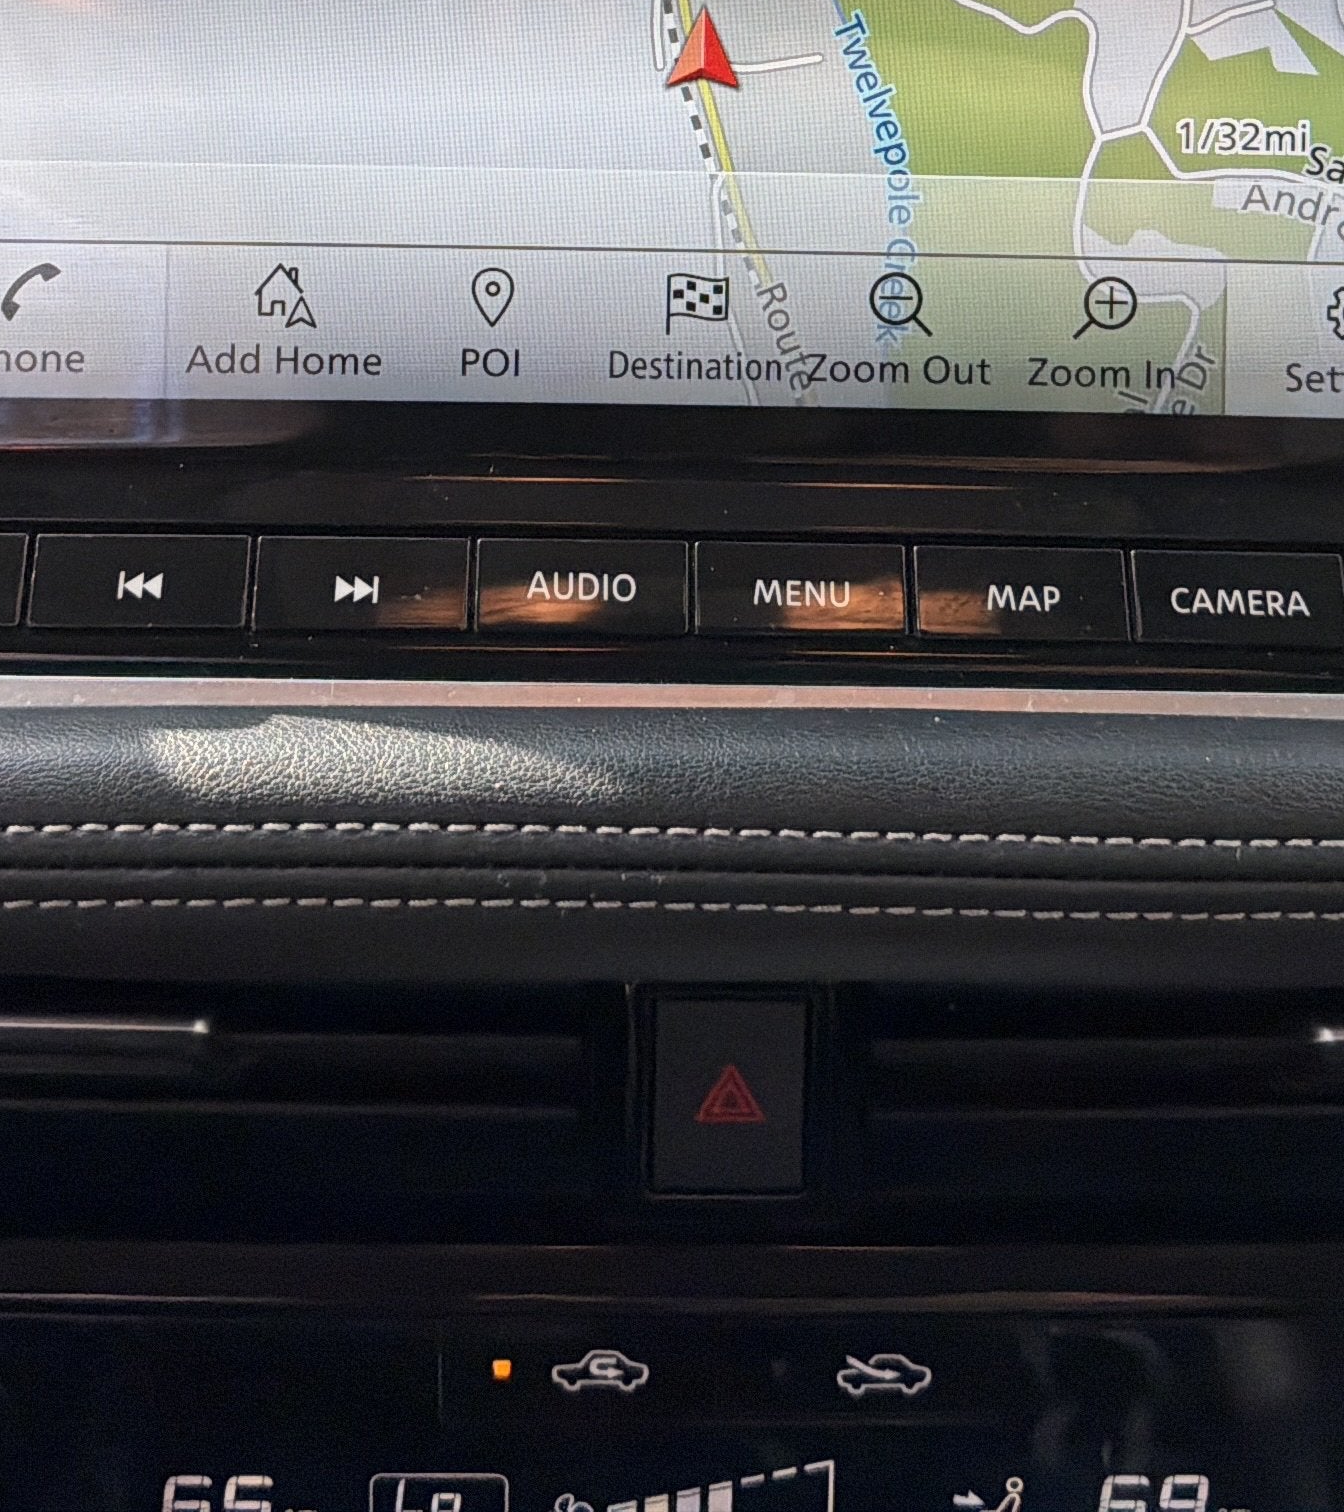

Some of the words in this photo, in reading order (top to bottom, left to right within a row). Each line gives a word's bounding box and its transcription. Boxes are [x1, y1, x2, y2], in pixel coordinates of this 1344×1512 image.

[834, 13, 920, 226] Twelvepole
[1178, 122, 1308, 152] 1/32mi
[875, 238, 917, 344] Creek
[758, 282, 812, 392] Route
[186, 344, 261, 376] Add
[276, 346, 383, 377] Home
[461, 348, 520, 378] POI
[608, 350, 782, 382] Destination
[806, 353, 910, 384] Zoom
[923, 355, 991, 386] Out
[1027, 357, 1131, 388] Zoom
[1145, 359, 1176, 389] In
[526, 570, 637, 603] AUDIO
[753, 578, 851, 609] MENU
[987, 584, 1061, 612] MAP
[1170, 587, 1311, 618] CAMERA
